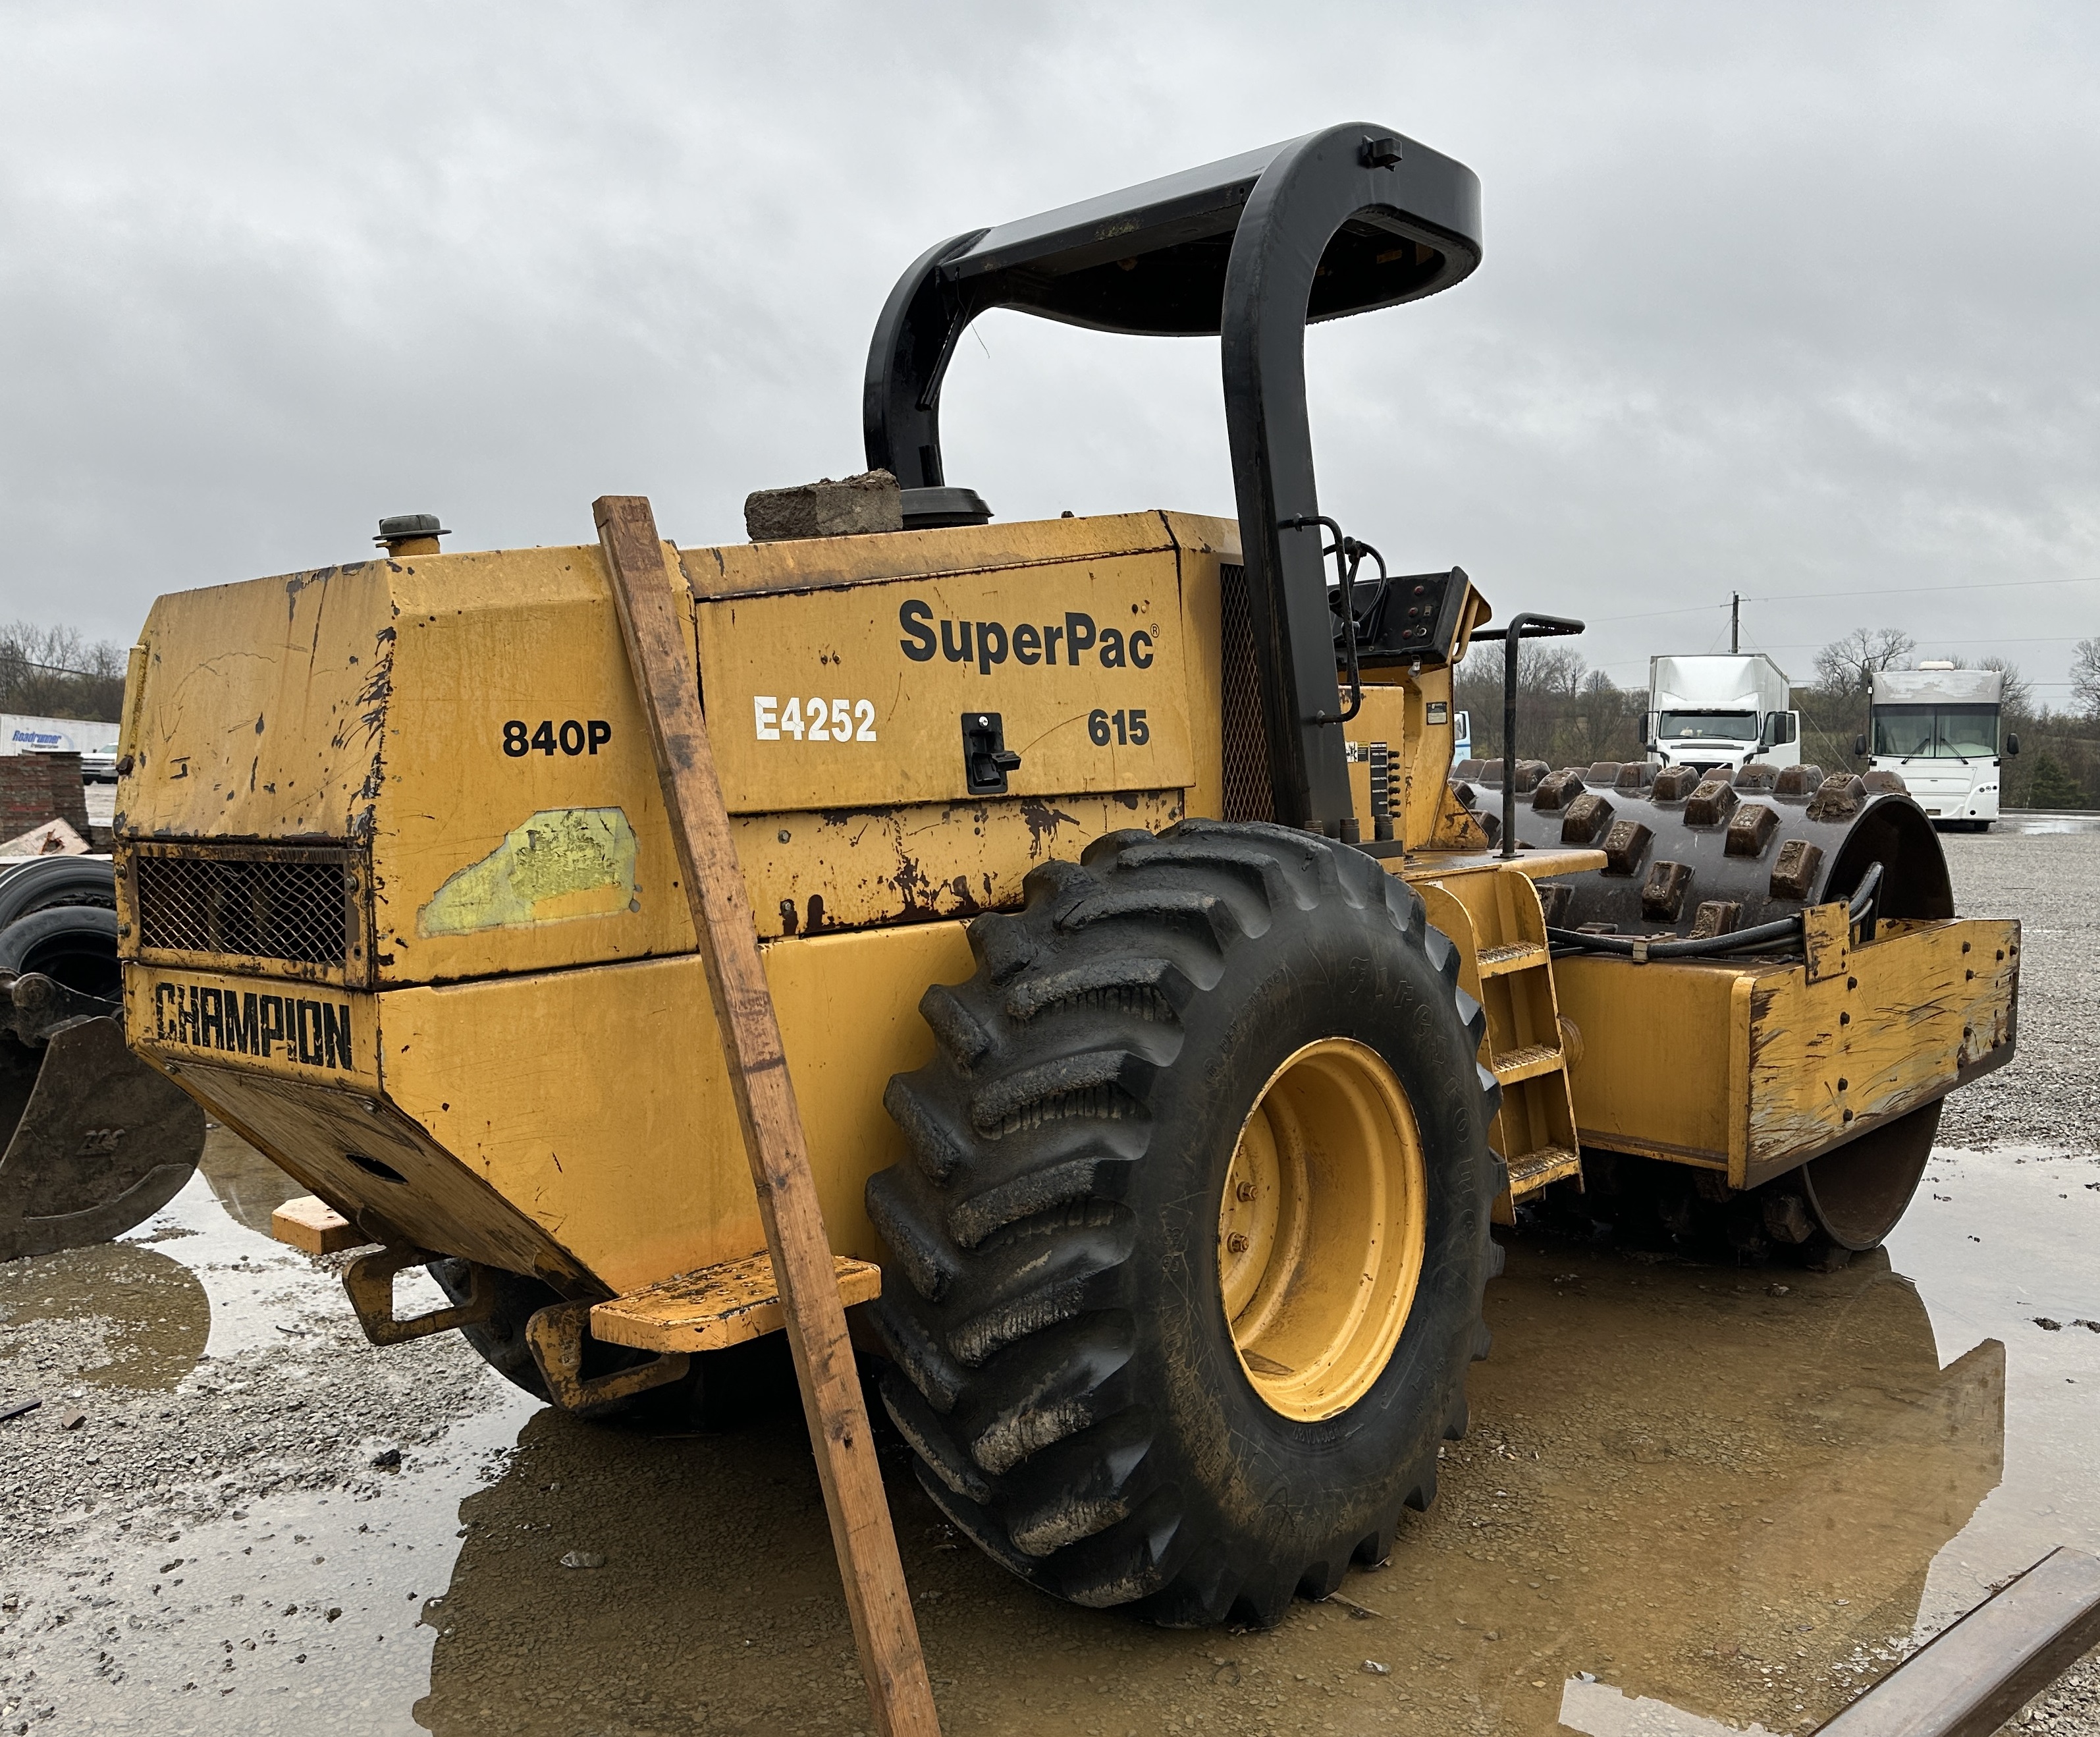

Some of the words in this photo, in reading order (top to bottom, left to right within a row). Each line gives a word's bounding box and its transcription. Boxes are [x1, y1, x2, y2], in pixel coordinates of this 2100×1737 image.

[13, 730, 61, 744] Roadrunner
[753, 696, 876, 742] E4252
[1088, 709, 1149, 746] 615
[502, 720, 612, 757] 840P
[155, 981, 352, 1070] CHAMPION
